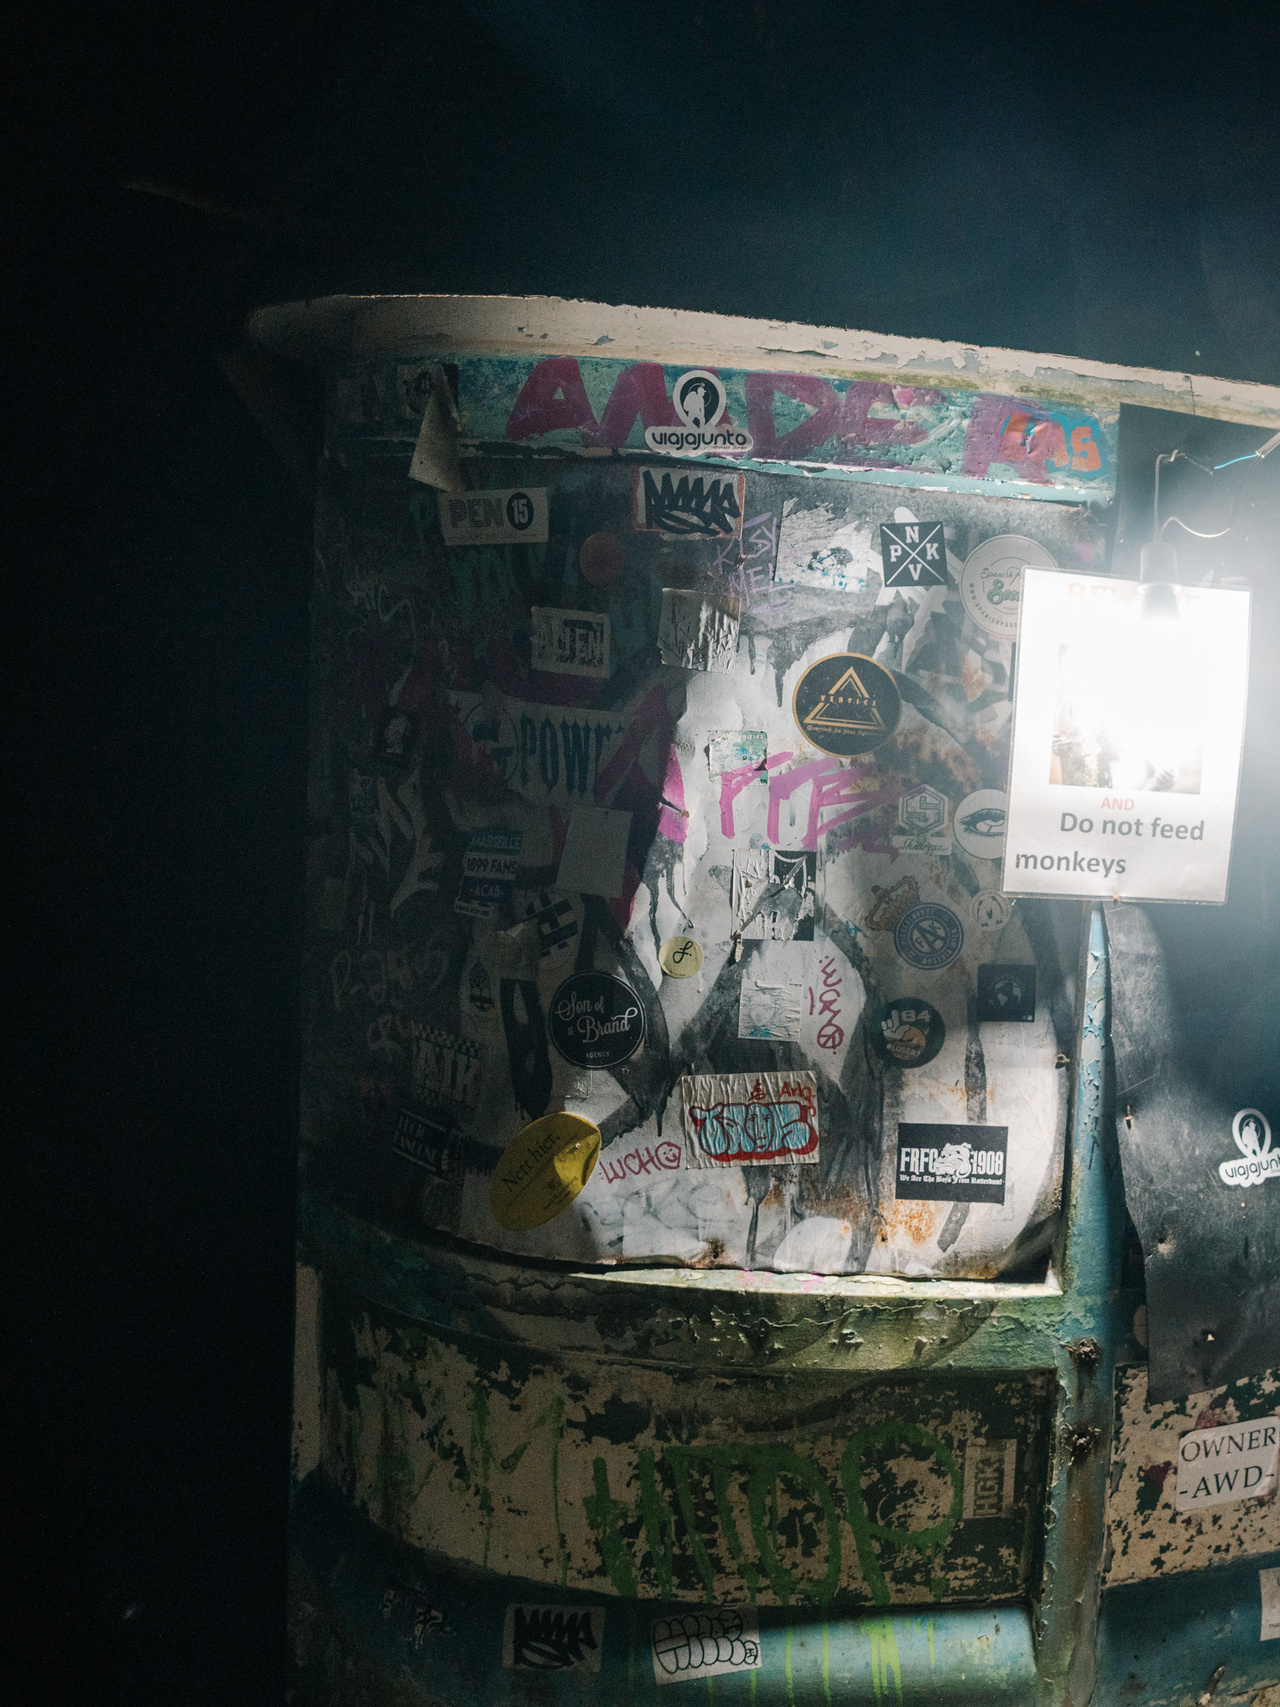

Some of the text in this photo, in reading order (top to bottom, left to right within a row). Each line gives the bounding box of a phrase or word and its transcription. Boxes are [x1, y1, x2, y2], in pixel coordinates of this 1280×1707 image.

[651, 429, 747, 450] viajajunto
[449, 498, 529, 528] PEN 15
[904, 525, 920, 543] N
[889, 542, 940, 562] P K
[907, 563, 923, 581] V
[820, 694, 877, 707] VERTICE
[1100, 796, 1136, 811] AND
[1059, 811, 1205, 841] Do not feed
[1014, 850, 1127, 878] monkeys
[555, 991, 606, 1021] Son of
[576, 1007, 639, 1044] Brand
[971, 1150, 1005, 1176] 1908
[1181, 1426, 1277, 1462] OWNER
[1179, 1465, 1275, 1499] -AWD-
